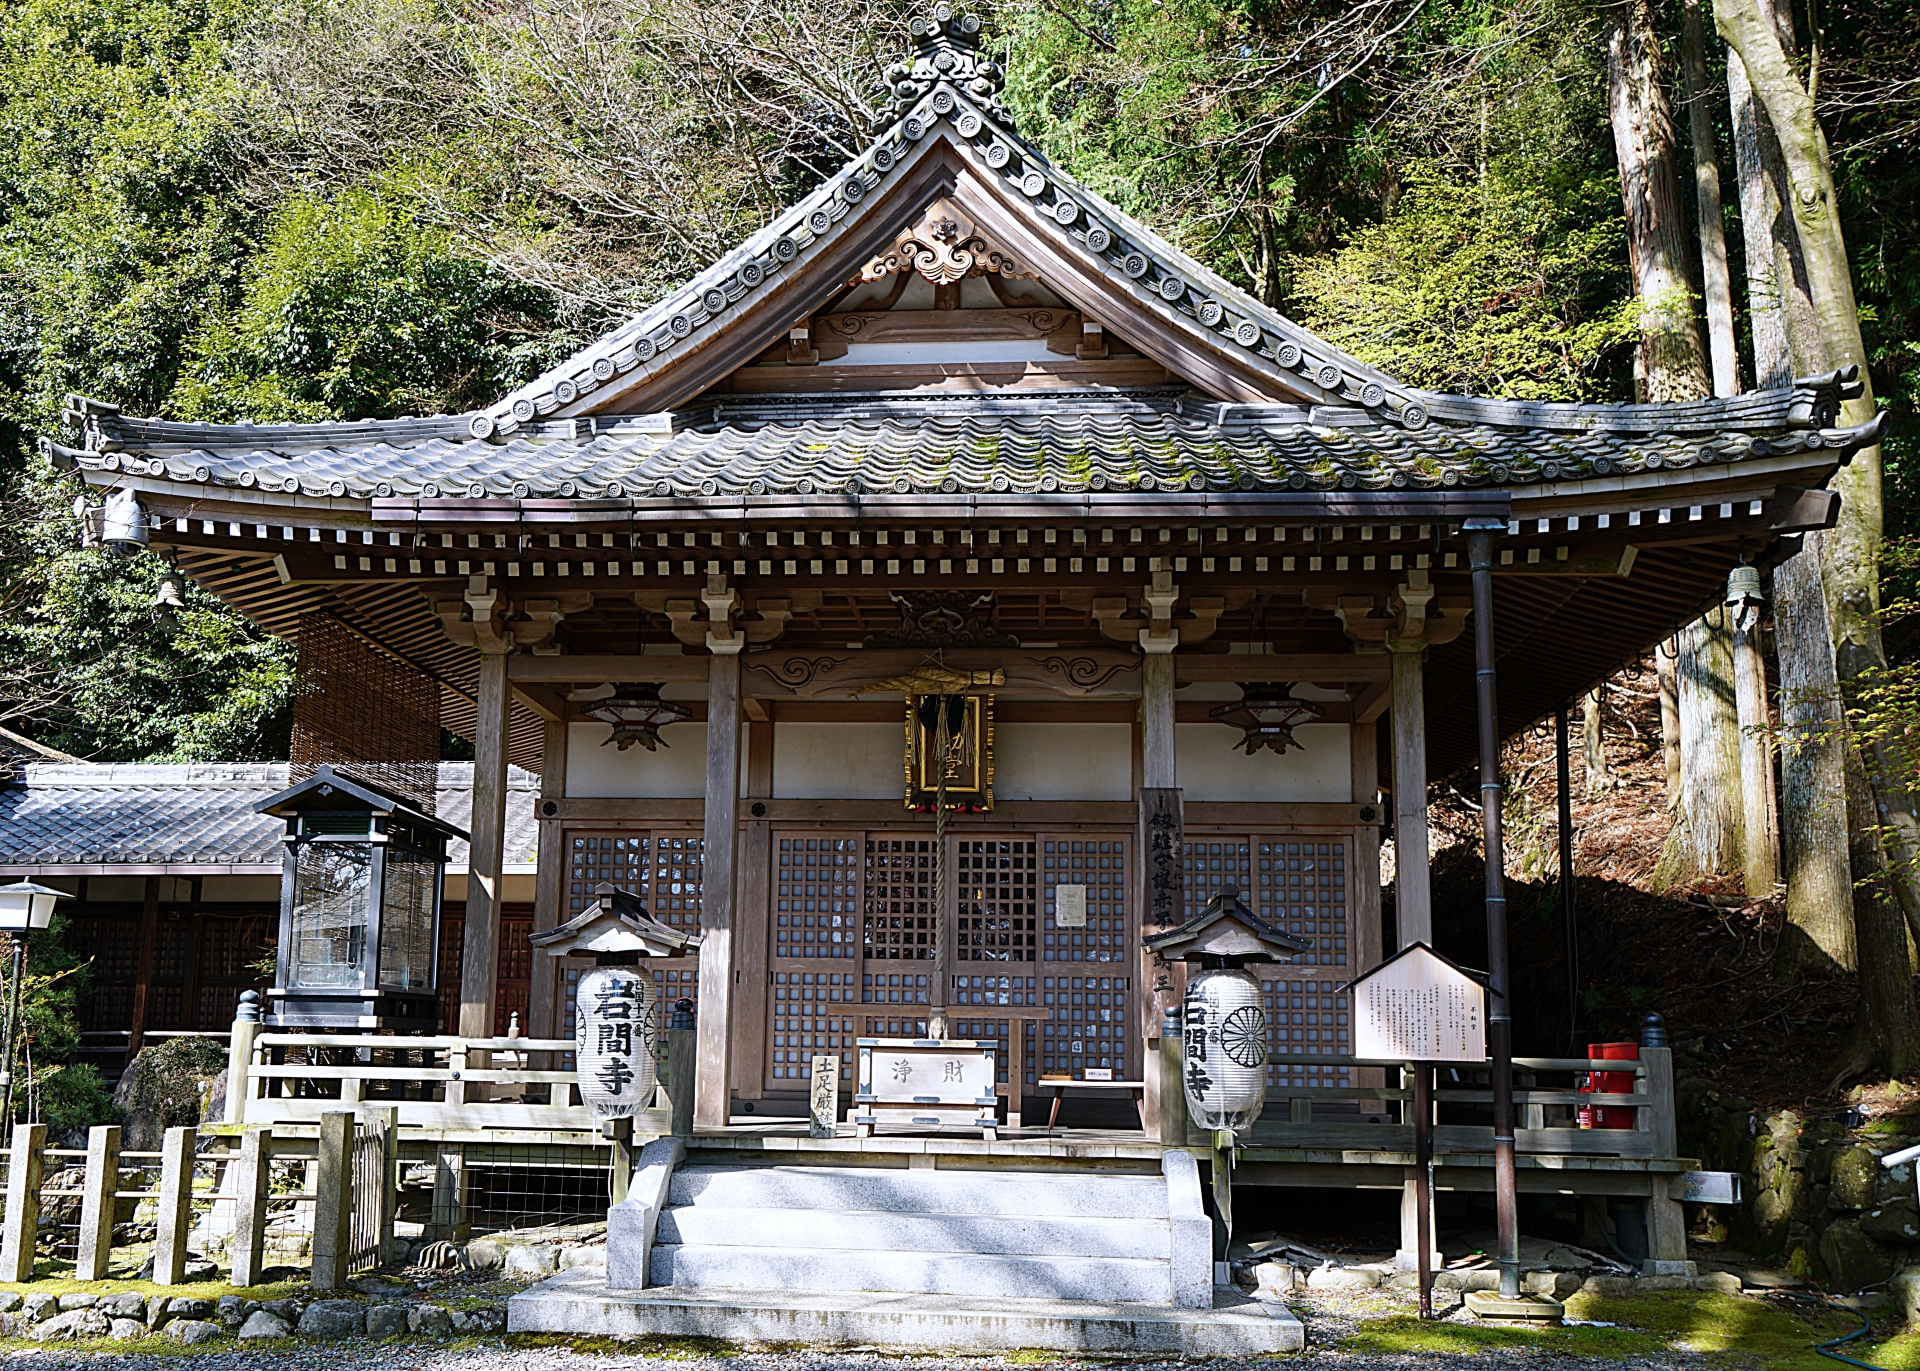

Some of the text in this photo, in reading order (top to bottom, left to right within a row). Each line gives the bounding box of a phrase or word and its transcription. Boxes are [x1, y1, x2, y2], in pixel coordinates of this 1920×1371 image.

[594, 978, 634, 1095] 岩間寺
[633, 980, 644, 1037] 西国十二番
[1184, 982, 1213, 1102] 岩間寺
[815, 1058, 835, 1131] 土足厳禁
